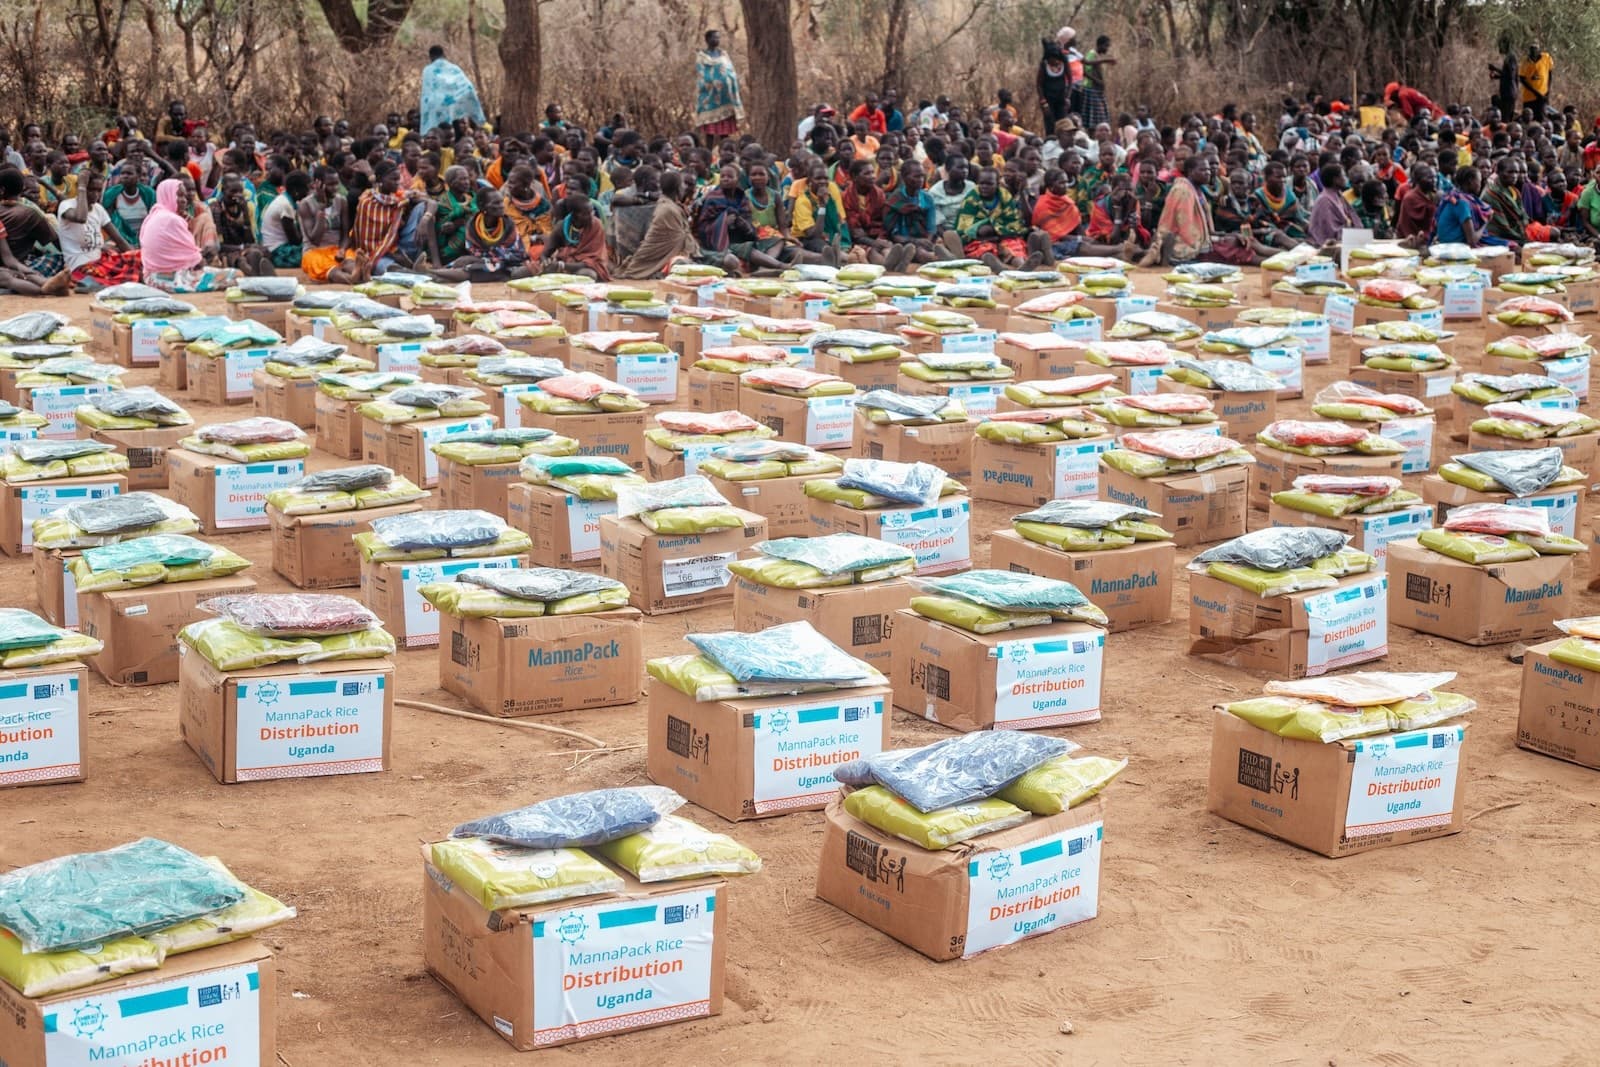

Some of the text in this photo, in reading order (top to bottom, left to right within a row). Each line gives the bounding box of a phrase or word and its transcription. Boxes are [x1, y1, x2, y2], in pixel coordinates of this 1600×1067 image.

[1222, 401, 1265, 416] MannaPack
[983, 469, 1033, 488] MannaPack
[898, 536, 954, 551] istribution
[679, 573, 692, 582] 166
[1091, 570, 1158, 595] MannaPack
[1505, 580, 1563, 604] MannaPack
[1324, 618, 1376, 644] Distribution
[528, 640, 620, 667] MannaPack
[564, 665, 584, 676] Rice
[1016, 663, 1085, 679] MannaPack Rice
[1534, 661, 1584, 684] MannaPack
[1012, 678, 1085, 696] Distribution
[504, 700, 514, 708] 36
[1033, 697, 1067, 711] Uganda
[28, 711, 52, 721] Rice
[266, 706, 358, 722] MannaPack Rice
[260, 722, 359, 741] Distribution
[1521, 730, 1530, 740] 36
[288, 744, 335, 759] Uganda
[777, 733, 859, 752] MannaPack Rice
[773, 750, 860, 772] Distribution
[1241, 751, 1258, 766] FEED
[1241, 763, 1267, 780] STARVING
[1374, 760, 1443, 777] MannaPack Rice
[798, 772, 836, 789] Ugand
[1240, 773, 1268, 792] CHILDREN
[1367, 776, 1441, 796] Distribution
[1251, 798, 1283, 818] fmsc.org
[1387, 799, 1422, 815] Uganda
[997, 867, 1081, 900] MannaPack Rice
[989, 885, 1080, 921] Distribution
[1014, 912, 1056, 934] Uganda
[950, 935, 964, 946] 36
[569, 938, 683, 966] MannaPack Rice
[563, 959, 683, 991] Distribution
[597, 988, 652, 1009] Uganda
[89, 1022, 225, 1062] MannaPack Rice
